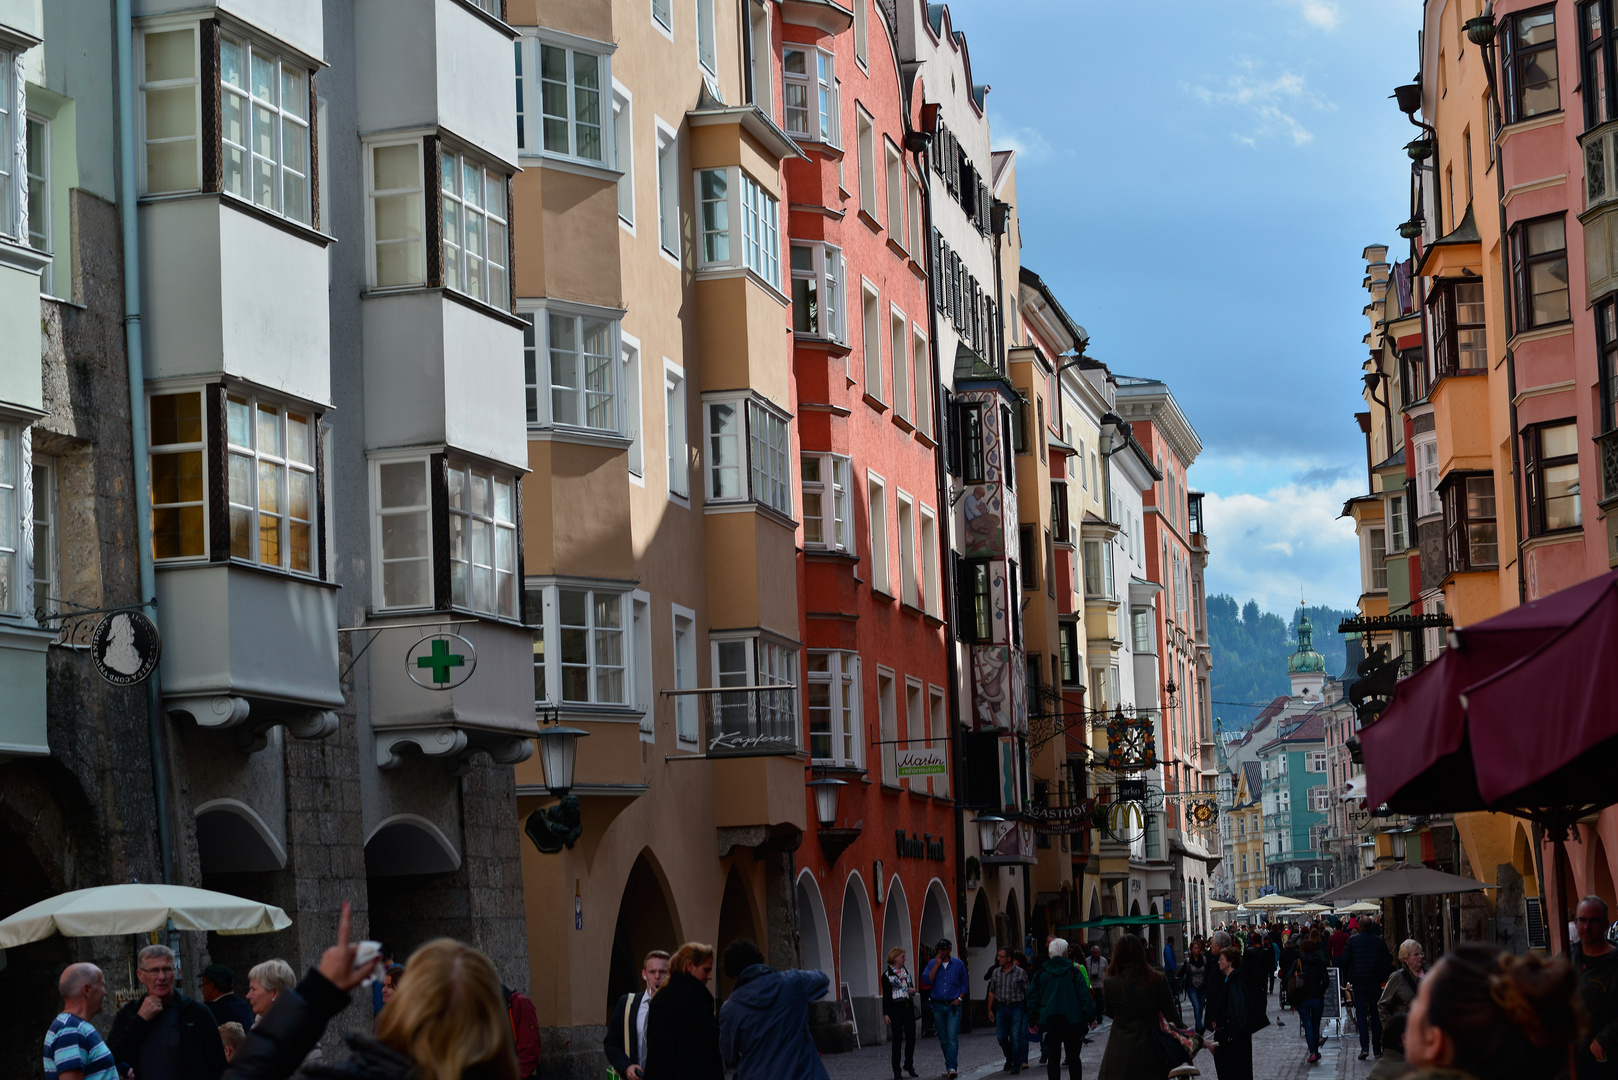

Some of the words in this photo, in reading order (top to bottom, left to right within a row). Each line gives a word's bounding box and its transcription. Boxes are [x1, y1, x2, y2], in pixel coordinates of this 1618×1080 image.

[708, 731, 792, 751] Kapferer
[897, 753, 945, 767] Martin
[901, 766, 942, 774] reformstark
[1122, 786, 1141, 796] arko
[1031, 802, 1088, 819] GASTHOF
